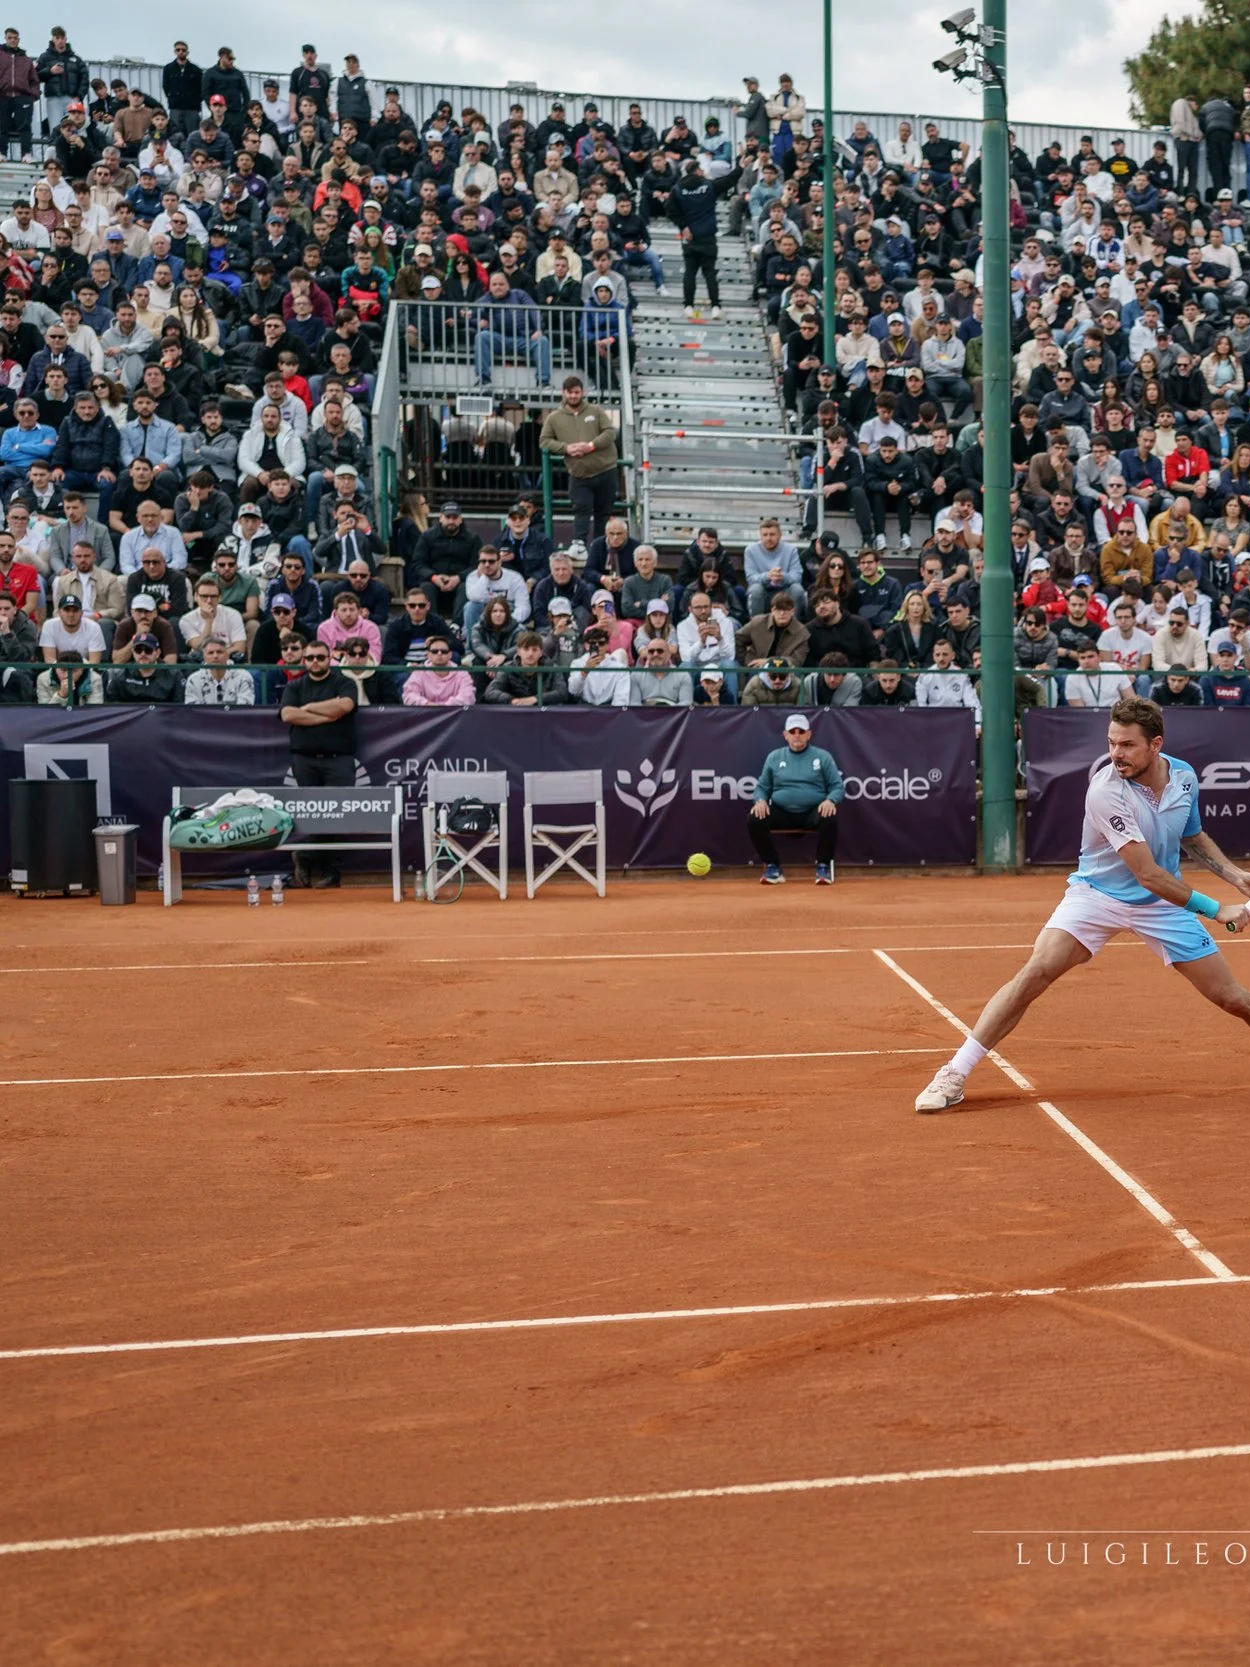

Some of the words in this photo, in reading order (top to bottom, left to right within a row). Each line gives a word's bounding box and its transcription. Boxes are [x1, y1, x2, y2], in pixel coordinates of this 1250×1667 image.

[384, 758, 488, 777] GRANDI
[285, 800, 339, 813] GROUP
[341, 800, 392, 813] SPORT
[219, 819, 266, 843] YONEX
